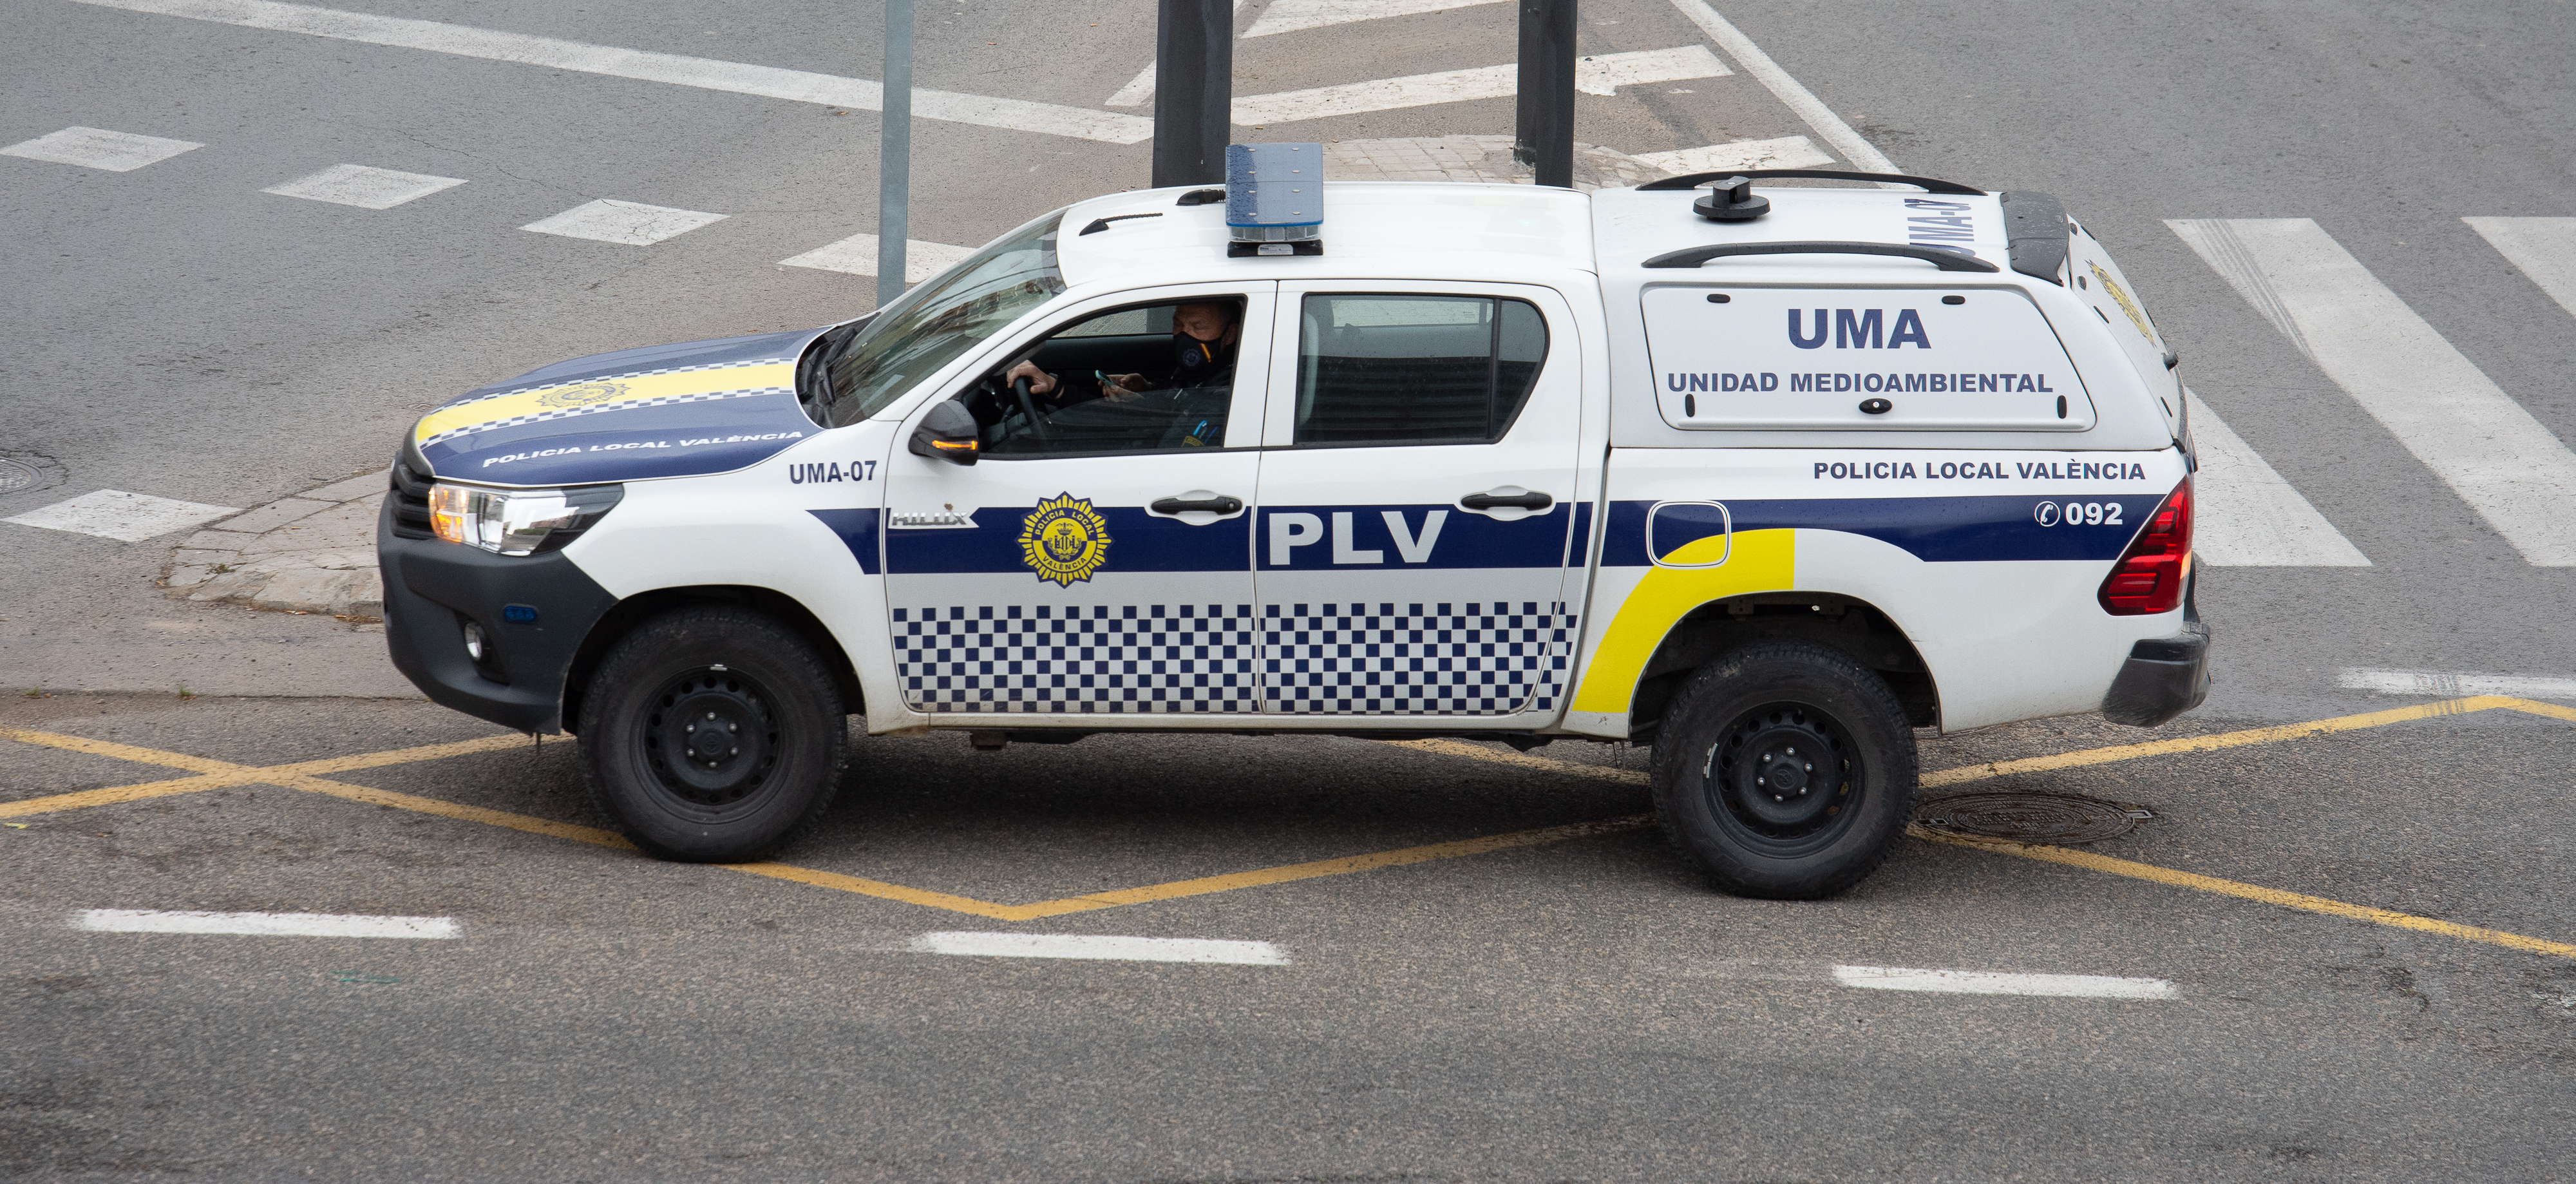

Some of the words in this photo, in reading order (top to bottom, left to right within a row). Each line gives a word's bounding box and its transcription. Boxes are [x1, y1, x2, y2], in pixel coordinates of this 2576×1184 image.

[1788, 309, 1932, 349] UMA
[1668, 372, 1779, 392] UNIDAD
[1791, 374, 2054, 392] MEDIOAMBIENTAL
[482, 446, 582, 468] POLICIA
[589, 441, 671, 451] LOCAL
[678, 431, 803, 446] VALÈNCIA
[790, 461, 876, 484] UMA-07
[1814, 463, 1917, 479] POLICIA
[1926, 463, 2009, 479] LOCAL
[2016, 459, 2146, 480] VALÈNCIA
[892, 512, 967, 526] HILUX
[1035, 510, 1065, 535] POLICIA
[1072, 511, 1095, 535] LOCAL
[2066, 502, 2123, 525] 092
[1269, 510, 1449, 566] PLV
[1043, 555, 1087, 570] VALÈNCIA
